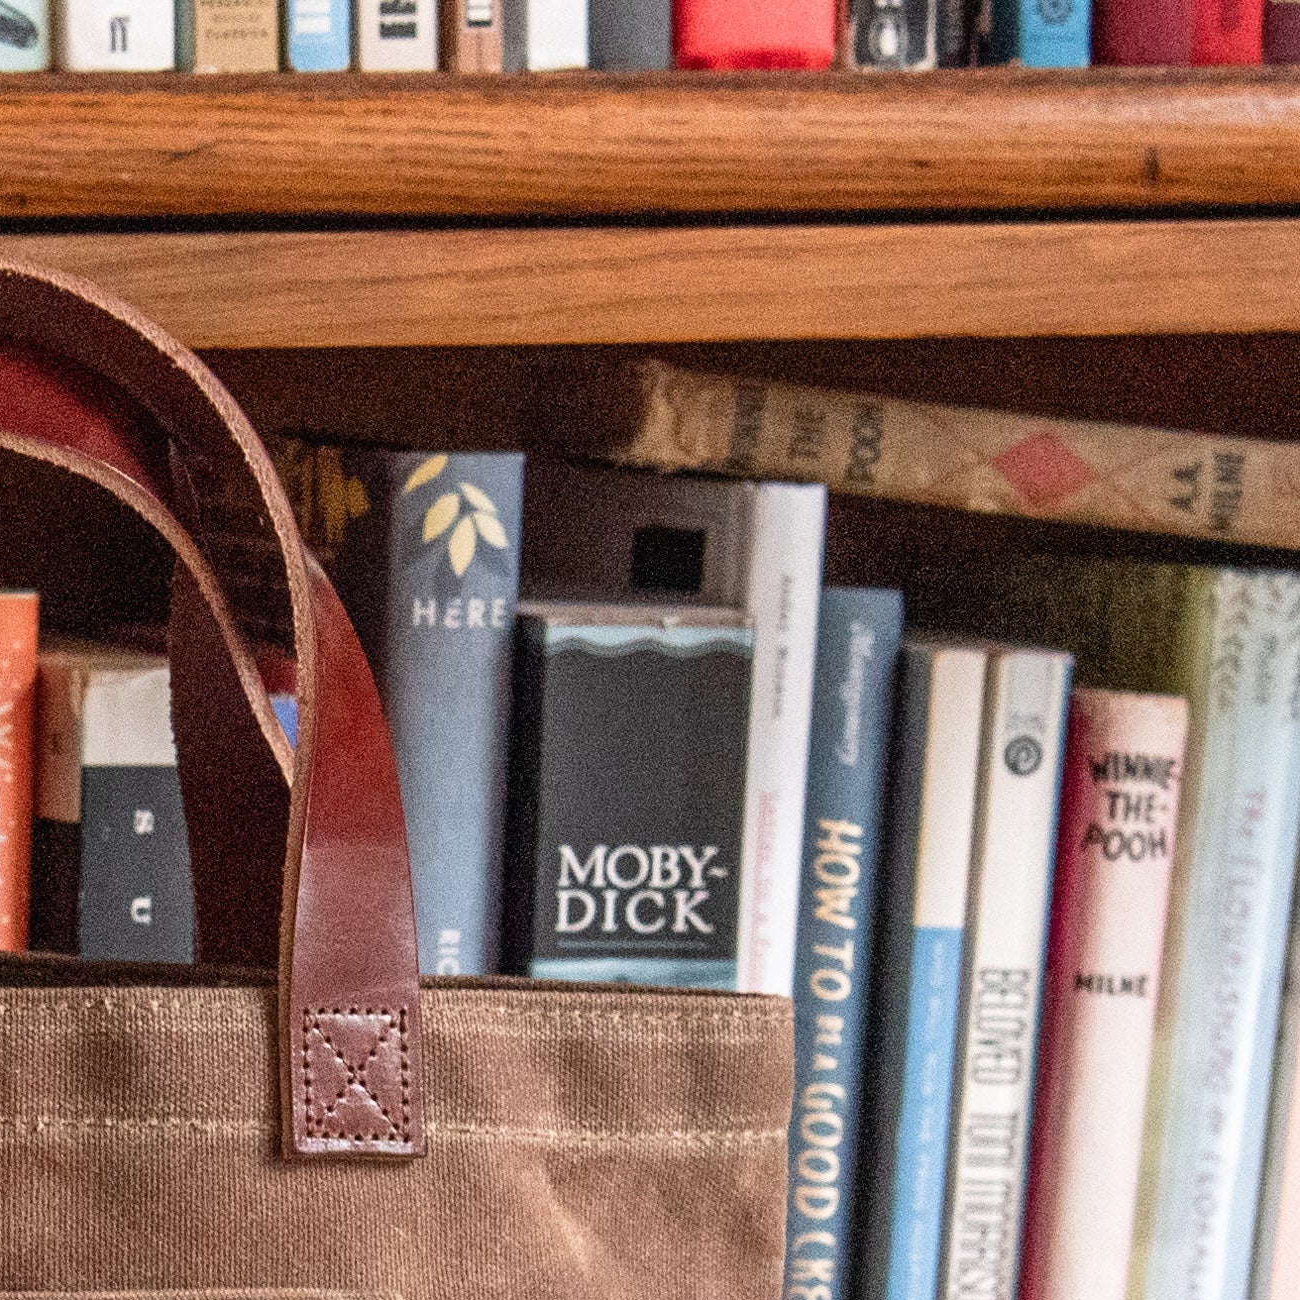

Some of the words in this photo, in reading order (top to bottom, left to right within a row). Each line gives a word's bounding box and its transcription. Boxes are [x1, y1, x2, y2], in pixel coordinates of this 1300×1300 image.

[411, 597, 508, 630] HERE
[1081, 822, 1167, 862] POOH
[556, 844, 729, 890] MOBY-
[813, 818, 864, 930] HOW
[554, 890, 714, 934] DICK
[809, 938, 855, 1002] TO
[1073, 971, 1149, 999] MILNE
[972, 967, 1032, 1086] BELOVED
[794, 1082, 847, 1221] GOOD
